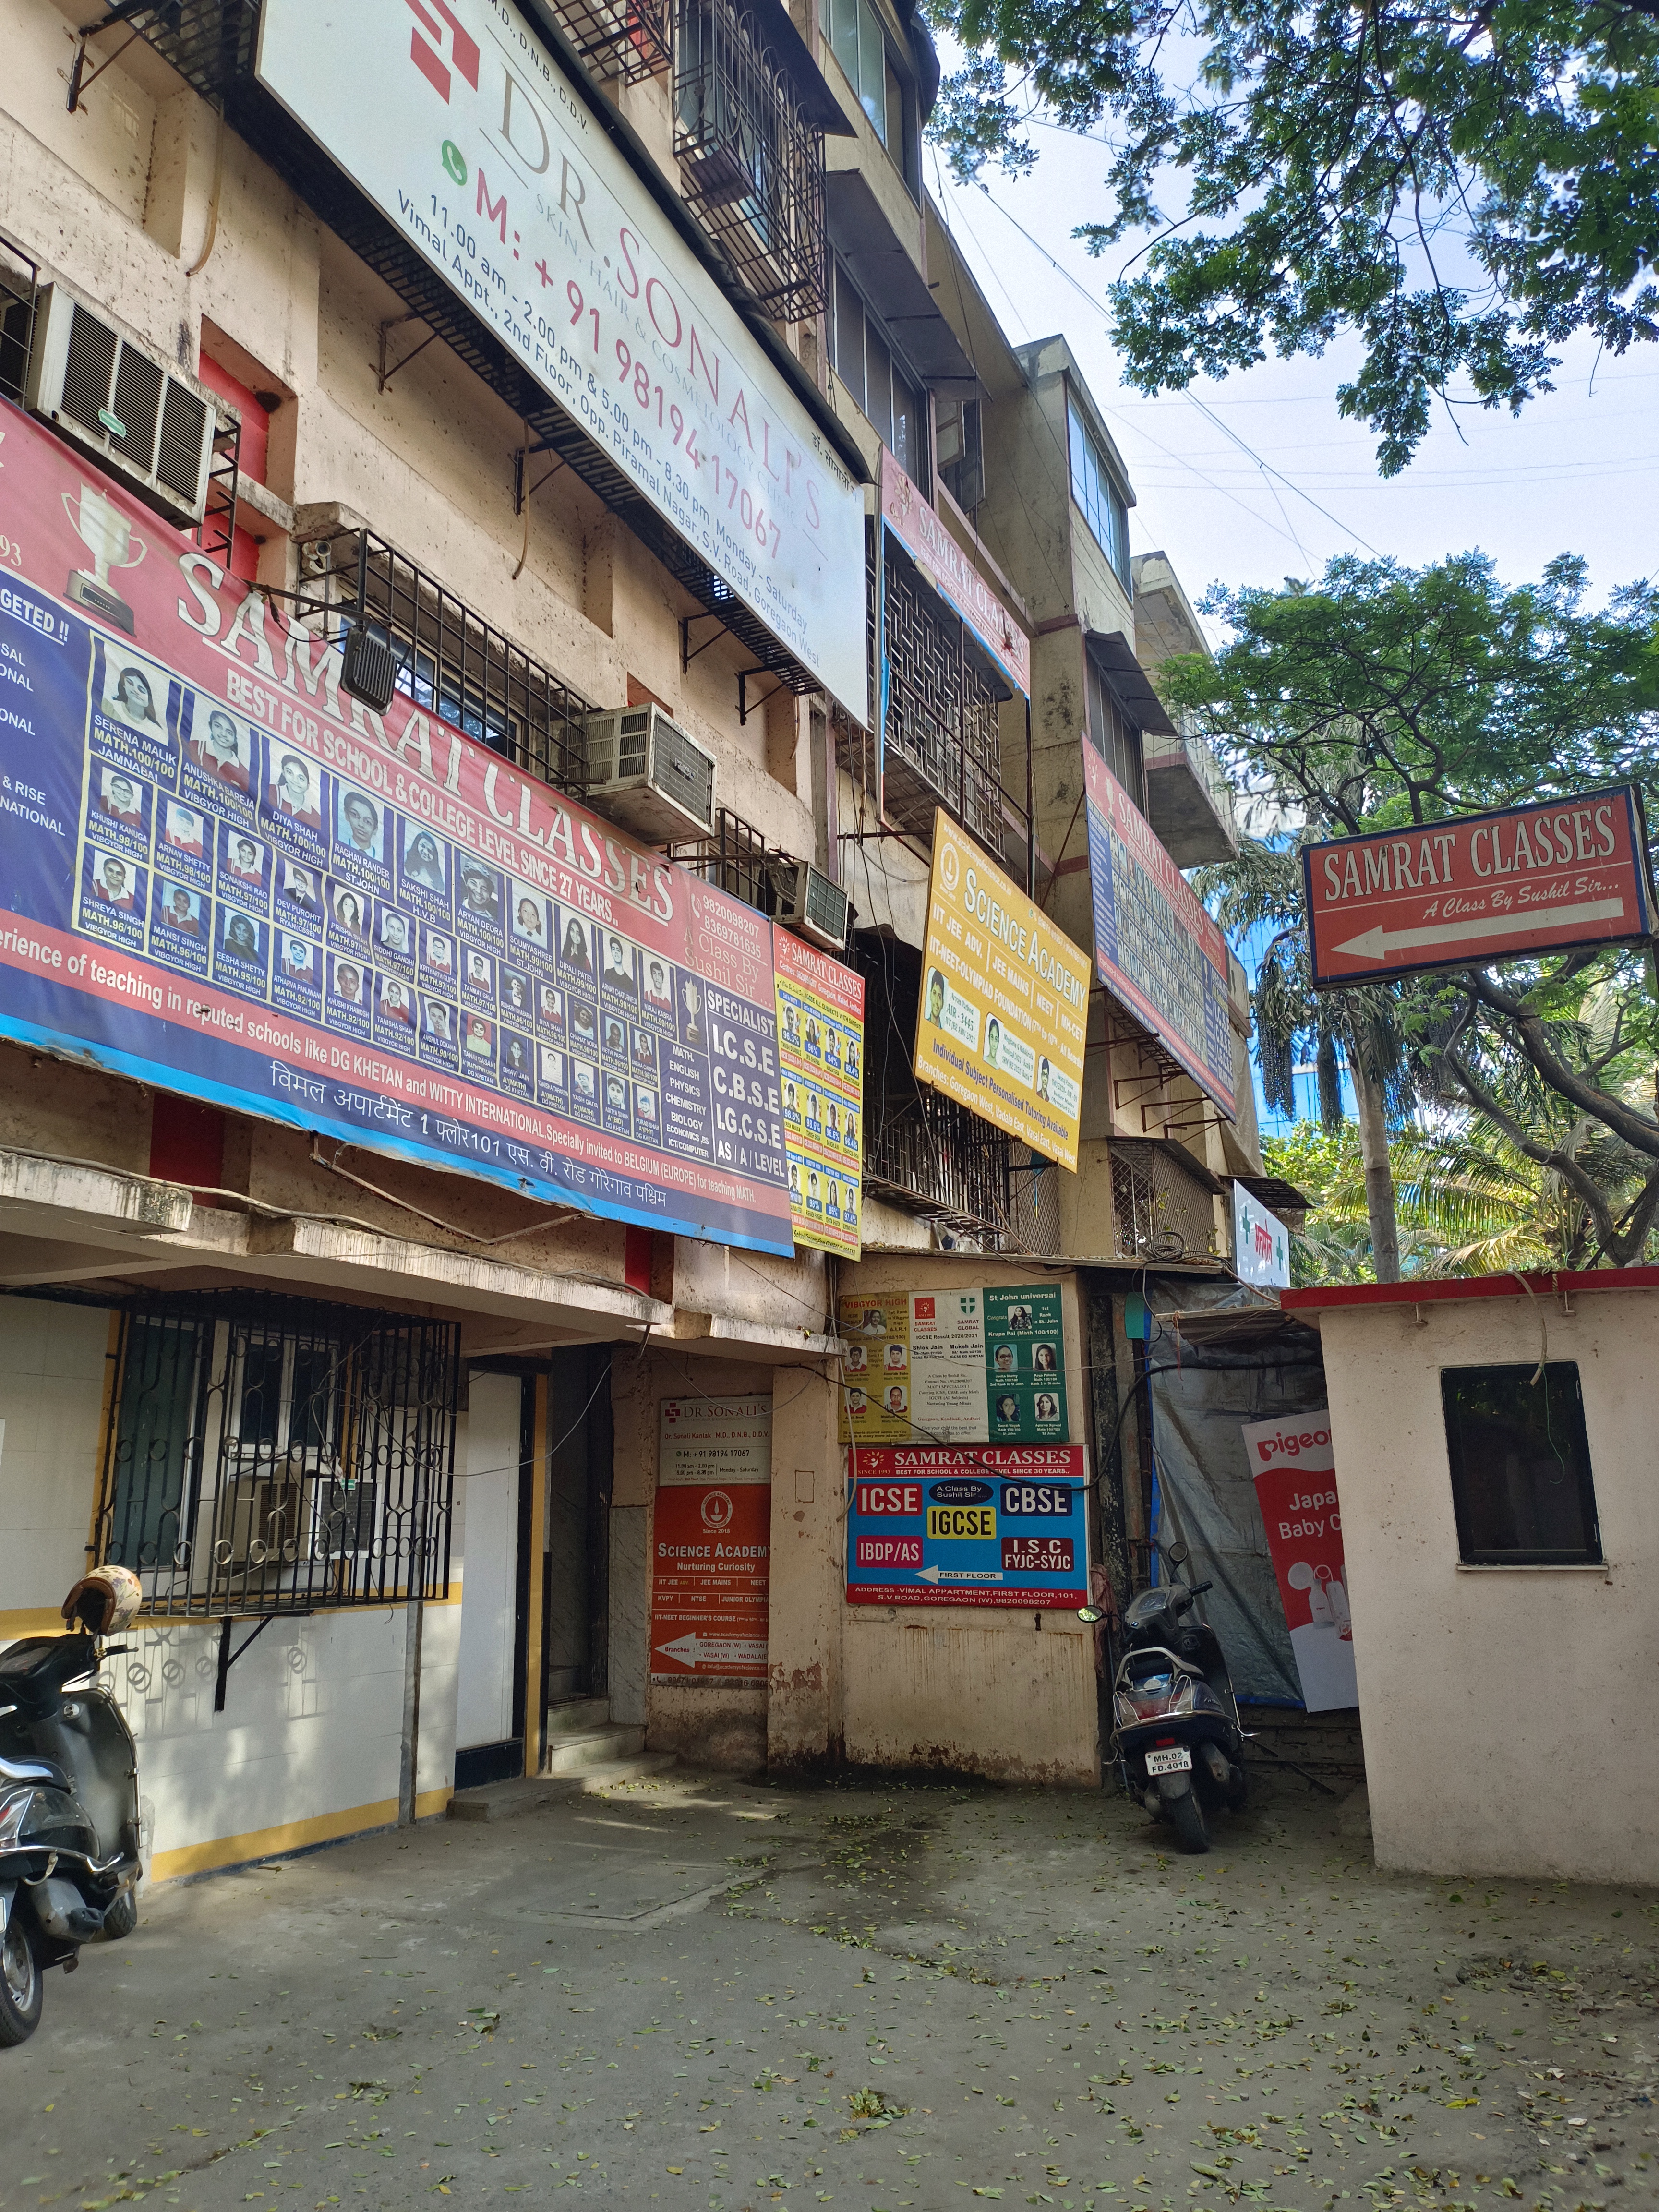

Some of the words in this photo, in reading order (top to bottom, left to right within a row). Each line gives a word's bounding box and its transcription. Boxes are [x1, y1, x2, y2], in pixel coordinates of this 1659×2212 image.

[520, 32, 556, 93] D.N.B.,
[559, 86, 589, 135] D.D.V.
[431, 195, 476, 259] 11.00
[481, 257, 506, 295] am
[524, 301, 555, 349] 2.00
[560, 346, 582, 380] pm
[602, 388, 629, 432] 5.00
[633, 428, 652, 460] pm
[665, 462, 689, 501] 8.30
[692, 496, 710, 526] pm
[716, 519, 757, 578] Monday
[766, 576, 807, 634] Saturday
[651, 340, 754, 472] COSMETOLOGY
[398, 189, 447, 261] Vimal
[504, 309, 530, 352] 2nd
[580, 394, 609, 439] Opp.
[613, 429, 660, 496] Piramal
[755, 588, 797, 644] Goregaon
[799, 637, 820, 669] West
[616, 339, 701, 470] 98194
[711, 455, 781, 559] 17067
[919, 506, 974, 598] SAMRAT
[94, 714, 139, 747] SERENA
[141, 743, 177, 767] MALIK
[94, 726, 175, 779] MATH.100/100
[98, 745, 158, 783] JAMNABAI
[15, 781, 46, 805] RISE
[227, 668, 278, 725] BEST
[281, 705, 319, 752] FOR
[323, 731, 394, 796] SCHOOL
[395, 773, 408, 803] &
[409, 781, 476, 845] COLLEGE
[478, 823, 520, 869] LEVEL
[520, 850, 557, 892] SINCE
[559, 871, 573, 900] 27
[0, 795, 66, 836] NATIONAL
[184, 789, 226, 816] VIBGYOR
[227, 805, 249, 828] HIGH
[272, 810, 293, 829] DIYA
[294, 822, 318, 842] SHAH
[335, 842, 361, 865] RAGHAV
[483, 761, 674, 921] CLASSES
[1323, 833, 1456, 901] SAMRAT
[1470, 805, 1616, 878] CLASSES
[1118, 791, 1166, 875] SAMRAT
[1166, 857, 1204, 934] CLASSES
[83, 896, 117, 917] SHREYA
[118, 911, 144, 927] SINGH
[401, 879, 428, 900] SAKSHI
[429, 895, 449, 910] SHAH
[1442, 895, 1487, 919] Class
[1491, 889, 1514, 911] By
[1517, 880, 1571, 905] Sushil
[457, 908, 480, 926] ARYAN
[481, 920, 503, 938] DEORA
[702, 895, 759, 939] 9820098207
[704, 915, 761, 959] 8369781635
[964, 867, 1027, 961] SCIENCE
[1027, 930, 1087, 1012] ACADEMY
[559, 960, 577, 975] DIPALI
[684, 946, 732, 988] Sushil
[698, 932, 737, 968] Class
[742, 954, 760, 984] By
[791, 942, 827, 979] SAMRAT
[828, 961, 862, 1000] CLASSES
[933, 902, 945, 925] IIT
[946, 916, 962, 941] JEE
[965, 932, 983, 959] ADV.
[992, 955, 1007, 979] JEE
[1007, 966, 1029, 996] MAINS
[1036, 992, 1054, 1017] NEET
[707, 989, 775, 1038] SPECIALIST
[712, 1023, 775, 1077] I.C.S.E
[67, 954, 88, 977] of
[90, 959, 163, 1010] teaching
[167, 986, 181, 1011] in
[247, 1021, 301, 1055] schools
[305, 1037, 327, 1064] like
[331, 1046, 350, 1072] DG
[353, 1054, 403, 1090] KHETAN
[406, 1076, 426, 1097] and
[429, 1081, 464, 1109] WITTY
[586, 1138, 613, 1163] invited
[624, 1150, 660, 1177] BELGIUM
[661, 1162, 696, 1190] (EUROPE)
[708, 1178, 735, 1201] teaching
[669, 1059, 700, 1081] ENGLISH
[669, 1077, 700, 1098] PHYSICS
[665, 1092, 707, 1116] CHEMISTRY
[713, 1066, 780, 1116] C.B.S.E
[932, 1038, 964, 1072] Individual
[965, 1063, 988, 1090] Subject
[989, 1076, 1024, 1112] Personalised
[1025, 1101, 1046, 1129] Tutoring
[1046, 1118, 1069, 1141] Available
[269, 1060, 327, 1104] विमल
[334, 1089, 414, 1128] अपार्टमेंट
[420, 1113, 428, 1135] 1
[506, 1142, 534, 1168] एस.
[539, 1151, 557, 1176] वी.
[562, 1156, 586, 1183] रोड
[671, 1111, 703, 1131] BIOLOGY
[716, 1102, 782, 1150] I.G.C.S.E
[668, 1138, 709, 1158] ICT/COMPUTER
[718, 1140, 732, 1161] AS
[754, 1151, 785, 1178] LEVEL
[844, 1299, 882, 1309] VIBGYOR
[1020, 1292, 1056, 1300] universal
[894, 1451, 978, 1466] SAMRAT
[982, 1450, 1070, 1466] CLASSES
[1256, 1429, 1334, 1461] pigeo
[861, 1487, 918, 1512] ICSE
[1005, 1487, 1068, 1513] CBSE
[1289, 1490, 1337, 1511] Japa
[931, 1510, 992, 1536] IGCSE
[1278, 1519, 1325, 1540] Baby
[658, 1542, 711, 1558] SCIENCE
[860, 1542, 920, 1561] IBDP/AS
[1005, 1553, 1071, 1570] FYJC-SYJC
[1013, 1539, 1061, 1554] I.S.C
[677, 1562, 716, 1573] Nurturing
[718, 1562, 756, 1574] Curiosity
[1152, 1760, 1190, 1773] FD.4018
[1153, 1751, 1184, 1763] MH.02
